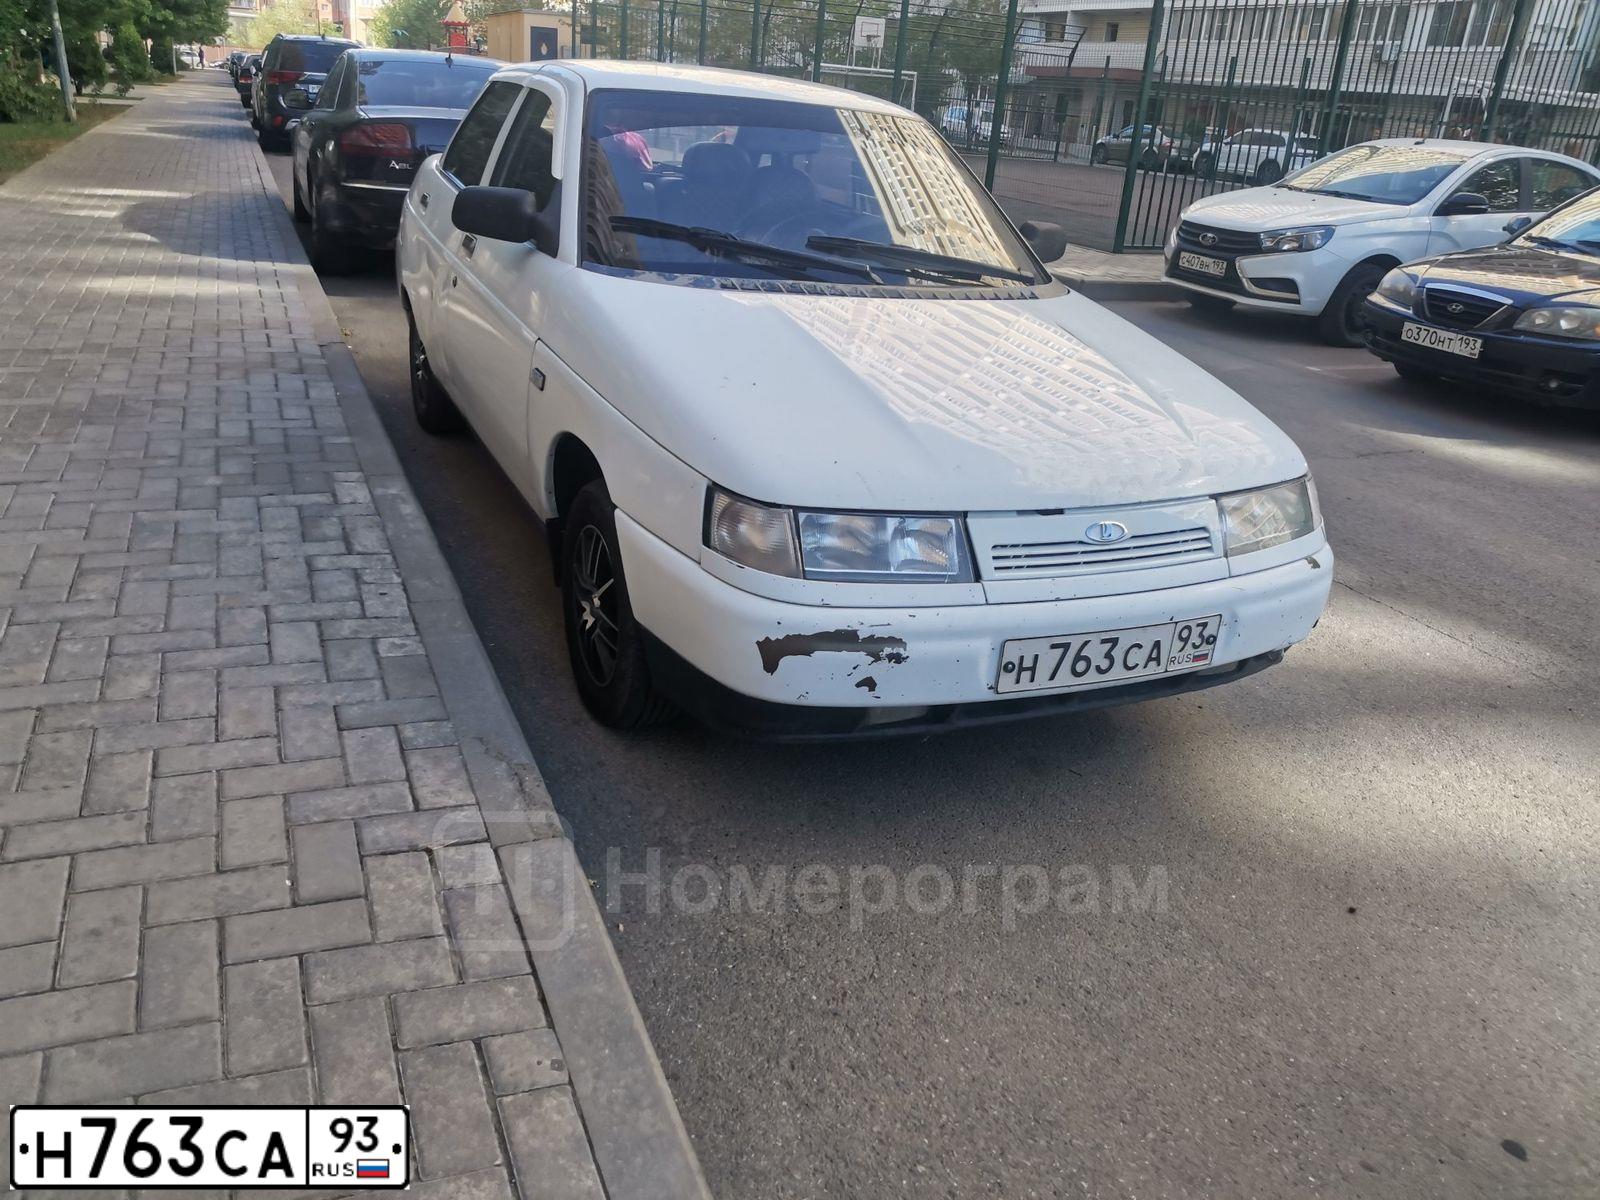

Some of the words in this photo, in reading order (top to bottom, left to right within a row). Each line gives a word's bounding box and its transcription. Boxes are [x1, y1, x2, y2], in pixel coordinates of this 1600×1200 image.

[1457, 336, 1477, 350] 193
[1014, 637, 1161, 684] Н763СА
[1178, 622, 1208, 652] 93
[1169, 653, 1192, 666] RUS
